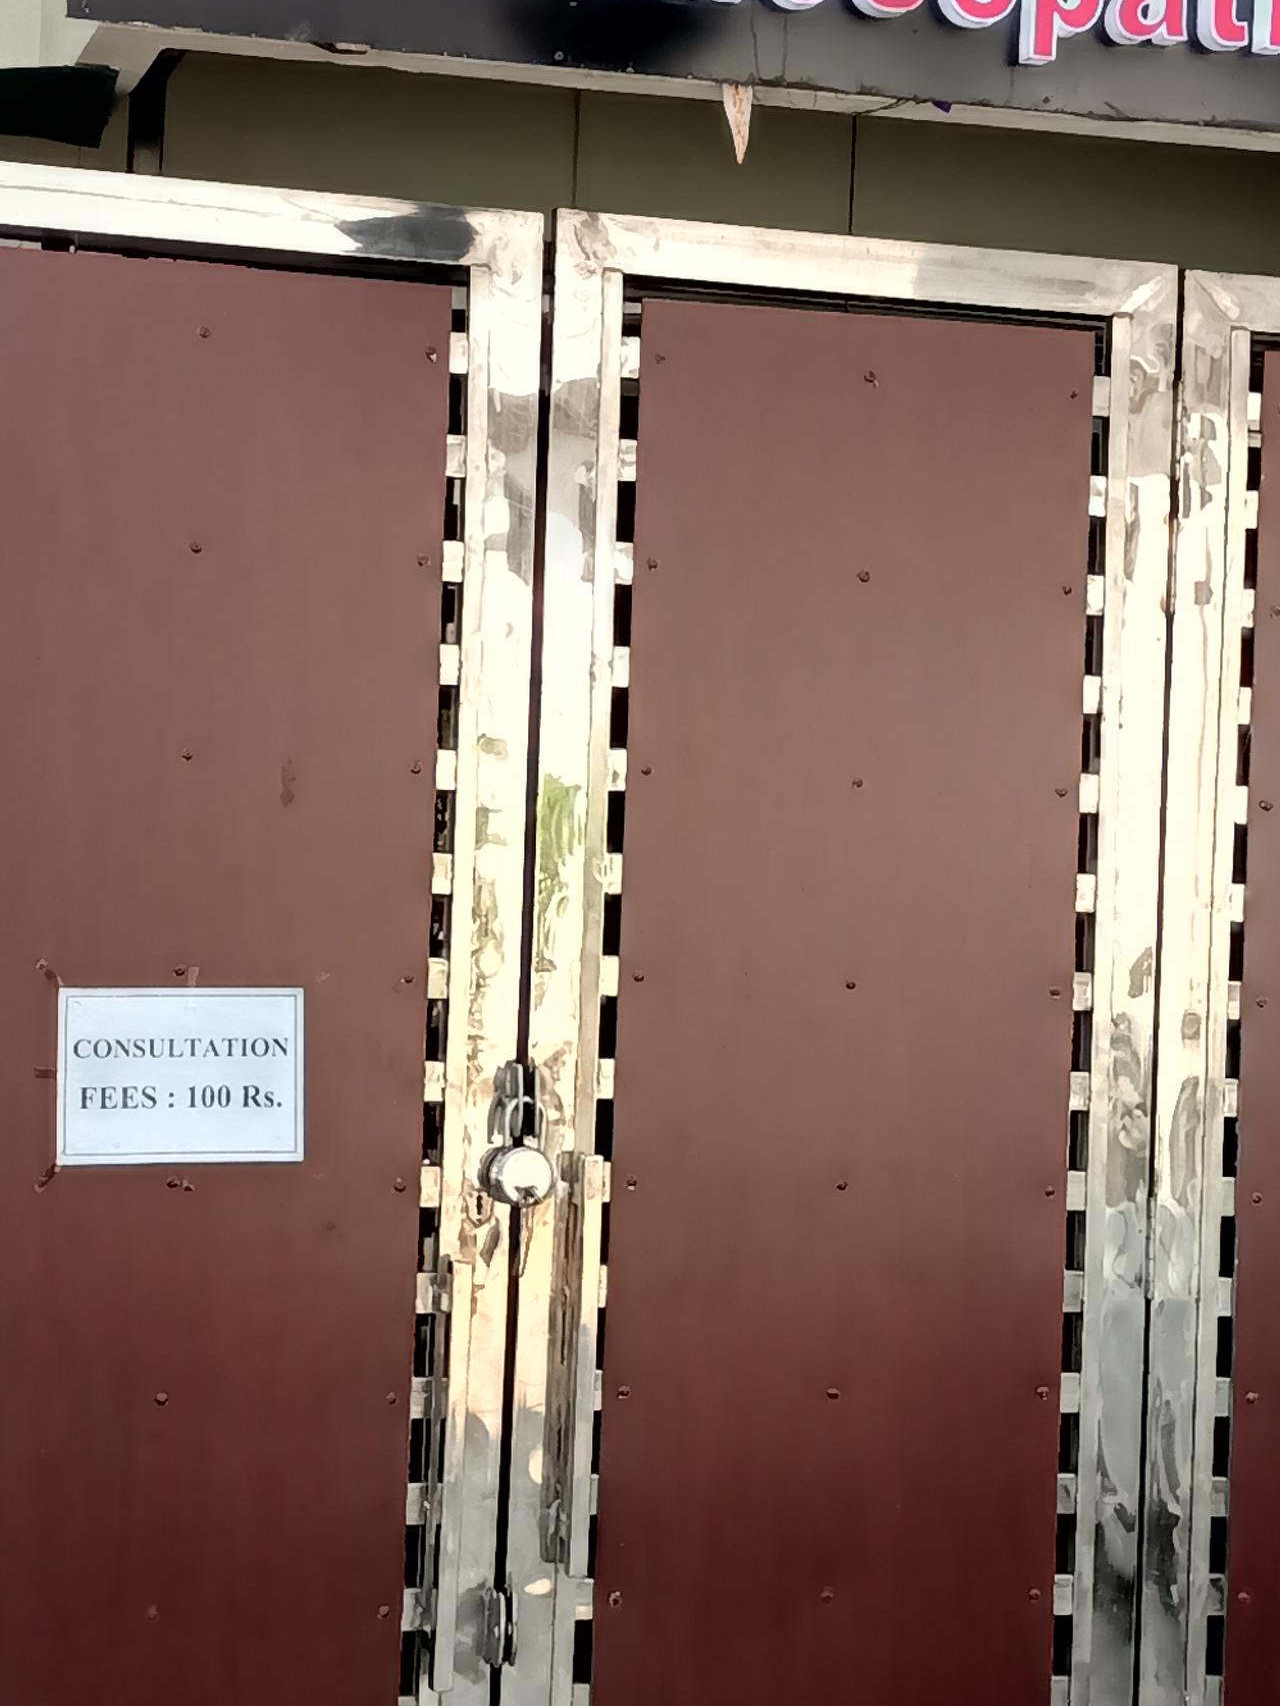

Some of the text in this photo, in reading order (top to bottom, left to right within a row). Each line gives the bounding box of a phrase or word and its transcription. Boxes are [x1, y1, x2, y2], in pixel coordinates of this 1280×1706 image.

[72, 1037, 289, 1059] CONSULTATION
[80, 1085, 158, 1110] FEES
[187, 1084, 231, 1110] 100
[241, 1084, 283, 1109] Rs.
